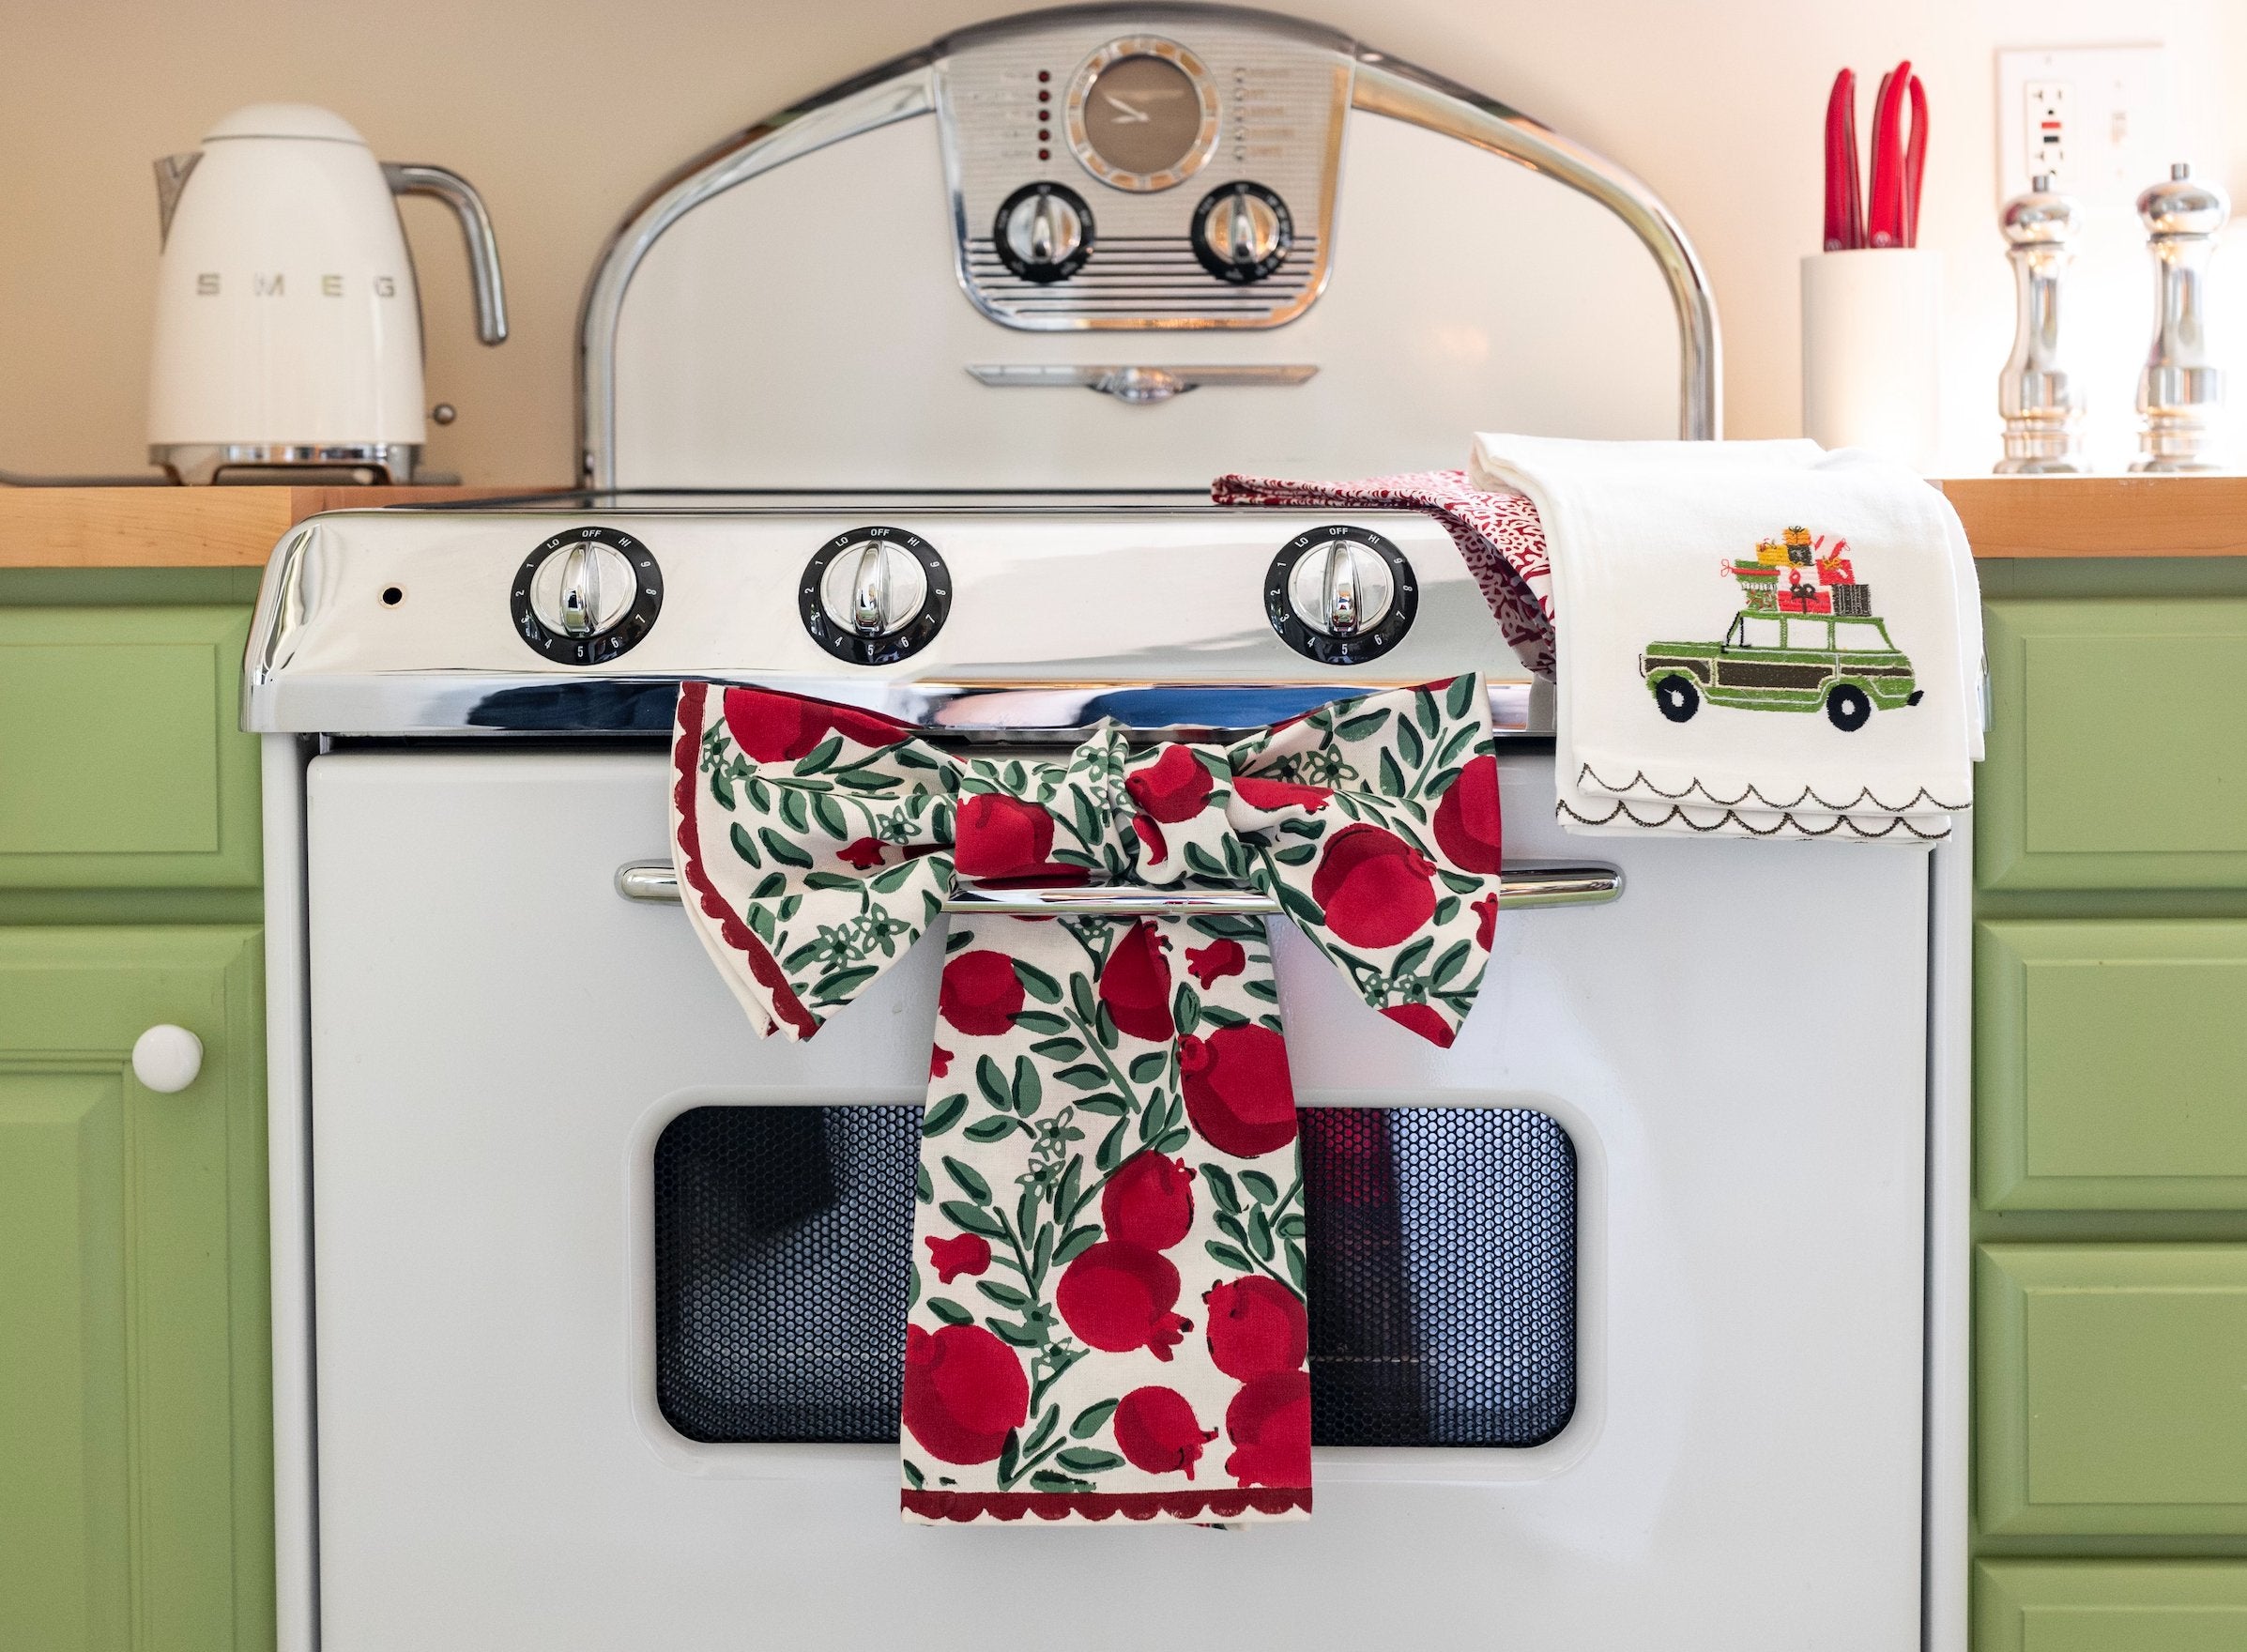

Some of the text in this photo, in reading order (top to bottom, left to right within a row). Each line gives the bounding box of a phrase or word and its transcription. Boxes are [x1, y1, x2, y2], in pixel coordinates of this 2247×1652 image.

[196, 272, 395, 298] SMEG
[582, 529, 602, 538] OFF
[1368, 534, 1380, 544] HI
[546, 538, 560, 549] LO
[618, 537, 632, 547] HI
[835, 537, 848, 547] LO
[907, 536, 920, 547] HI
[1294, 537, 1308, 548] LO
[646, 588, 657, 596] 8
[634, 614, 646, 624] 7
[925, 614, 935, 624] 7
[1396, 610, 1406, 620] 7
[544, 638, 553, 650] 4
[610, 637, 619, 649] 6
[834, 636, 843, 647] 4
[900, 636, 910, 648] 6
[1307, 636, 1316, 648] 4
[1374, 635, 1383, 645] 6
[577, 646, 584, 657] 5
[867, 645, 874, 655] 5
[1341, 644, 1348, 655] 5
